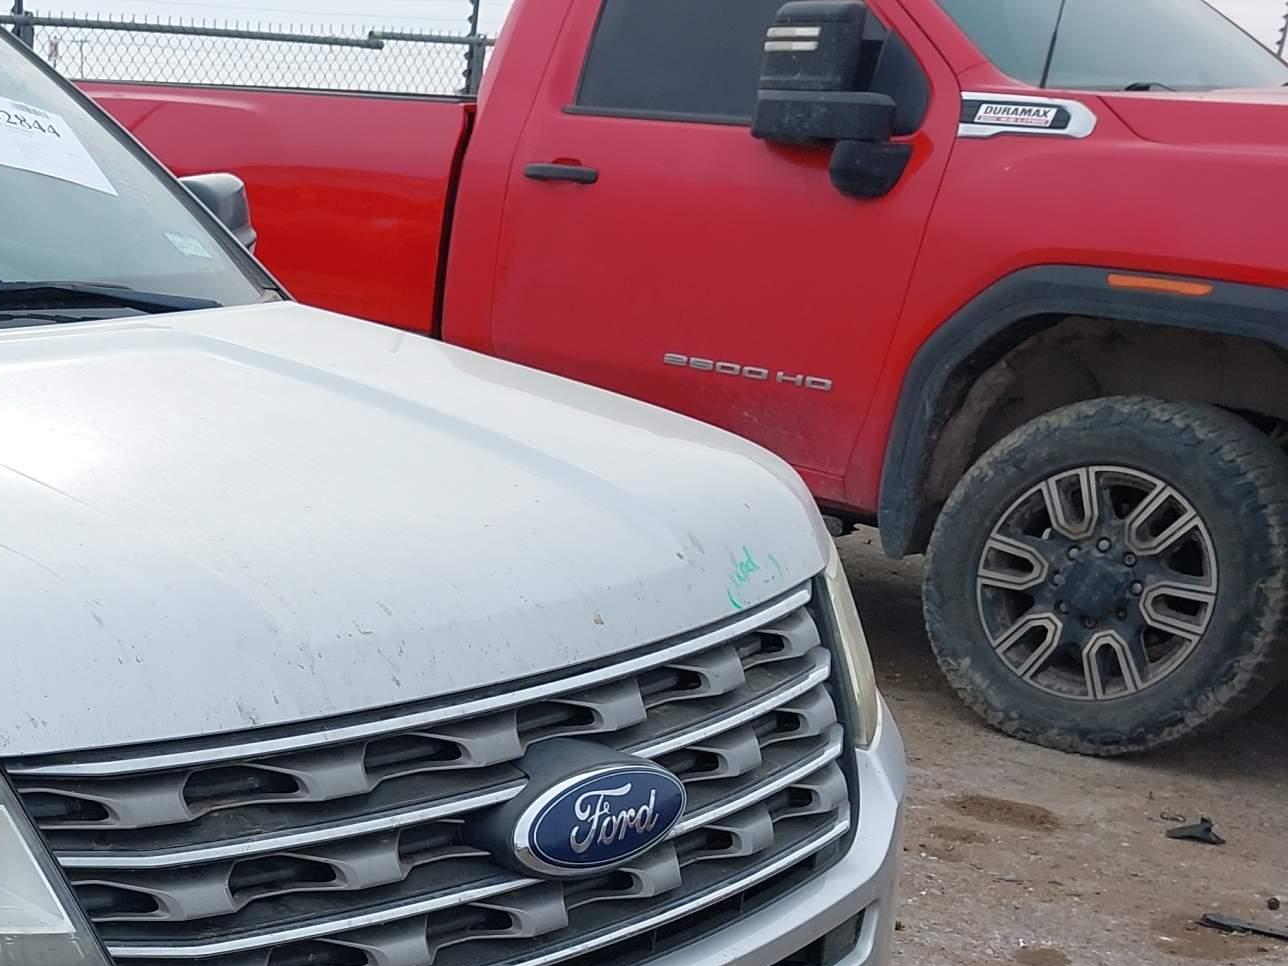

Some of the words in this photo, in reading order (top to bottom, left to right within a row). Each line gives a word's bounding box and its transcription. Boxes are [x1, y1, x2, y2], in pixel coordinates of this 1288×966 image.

[984, 105, 1050, 118] DURAMAX
[776, 371, 833, 391] HD
[570, 783, 659, 854] Ford
